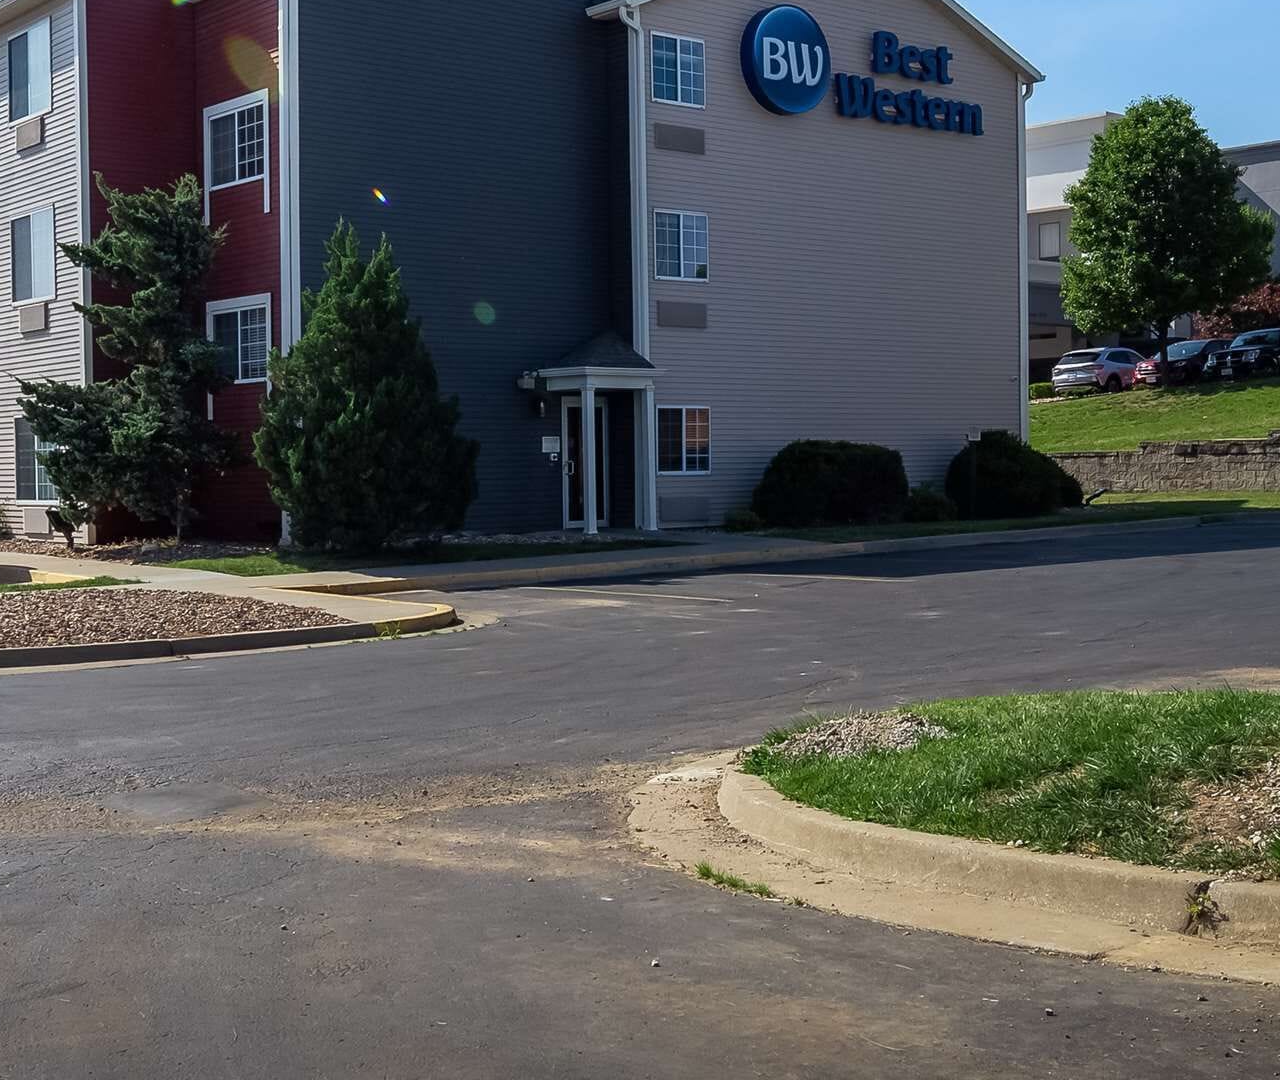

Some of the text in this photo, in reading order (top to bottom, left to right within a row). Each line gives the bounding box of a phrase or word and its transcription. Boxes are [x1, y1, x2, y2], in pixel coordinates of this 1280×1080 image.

[762, 36, 823, 87] BW
[872, 30, 953, 84] Best
[835, 72, 984, 136] Western
